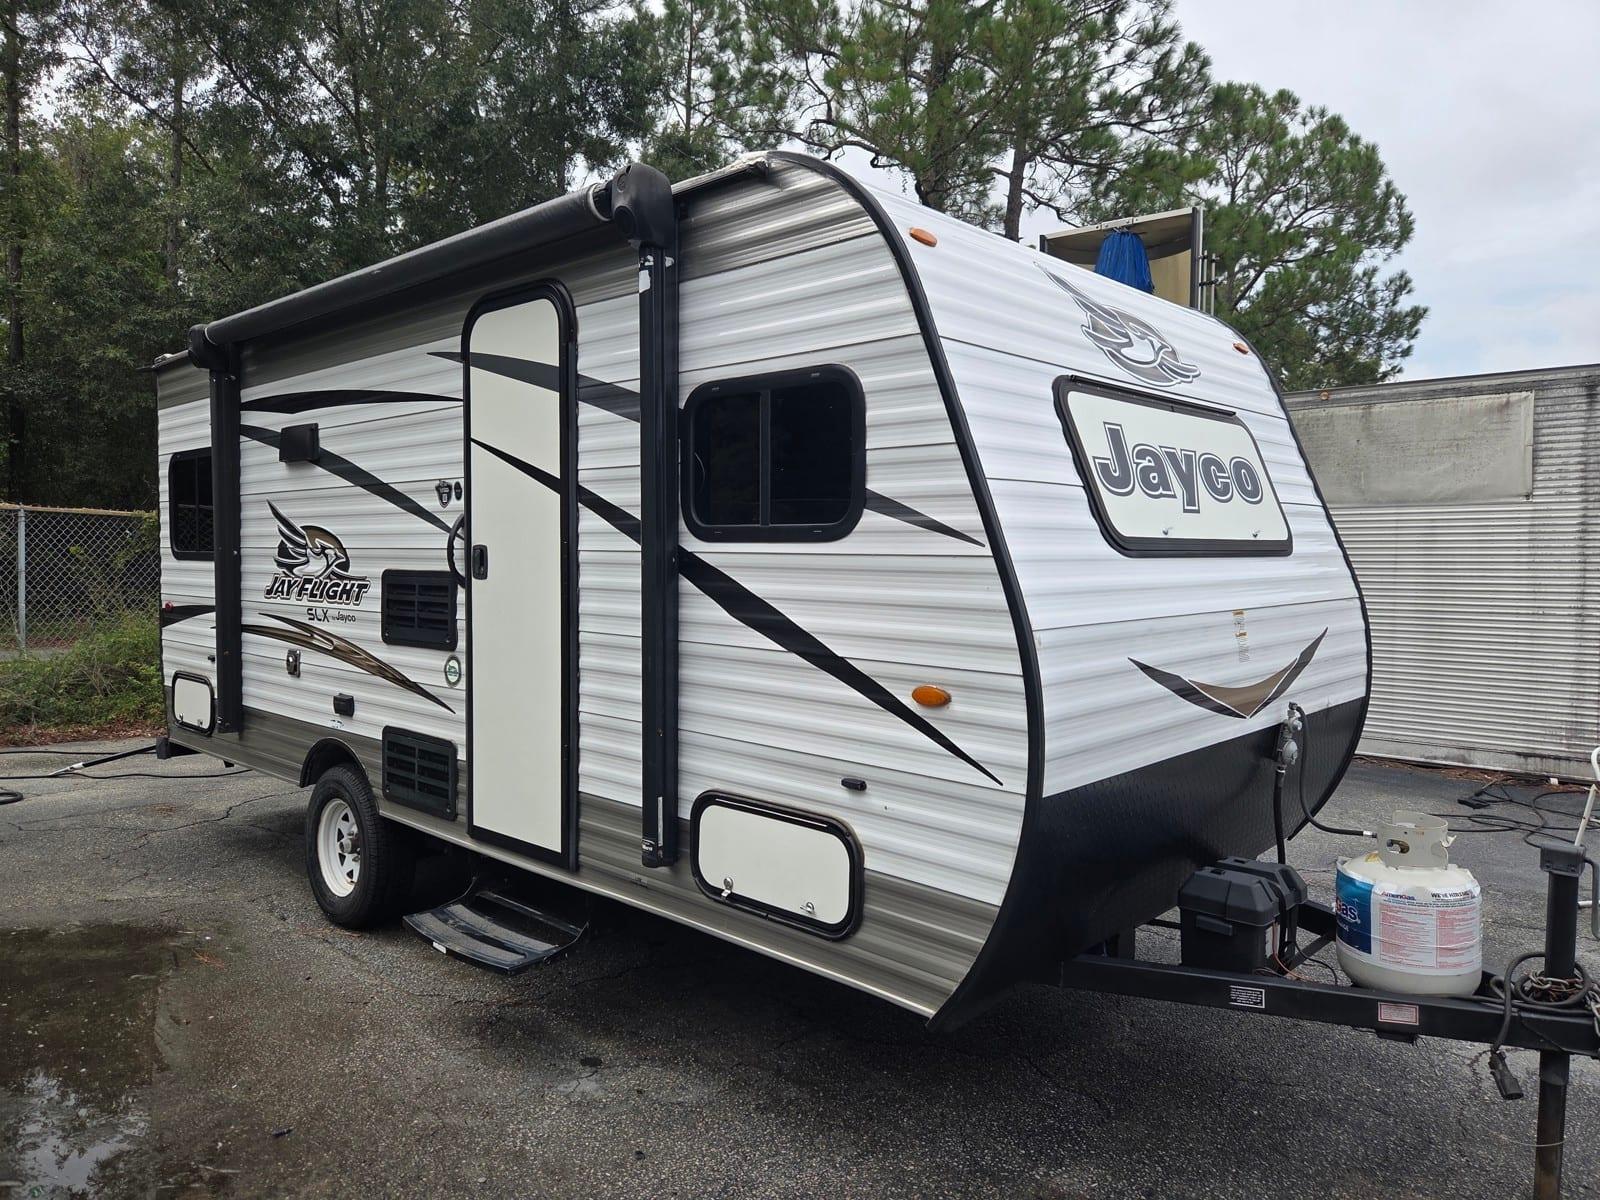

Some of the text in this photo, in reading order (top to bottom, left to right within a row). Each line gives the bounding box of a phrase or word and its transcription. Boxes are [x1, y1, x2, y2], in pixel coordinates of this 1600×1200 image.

[1092, 421, 1264, 514] Jayco
[264, 573, 371, 606] JAY FLIGHT
[306, 608, 357, 623] SLX Jayco
